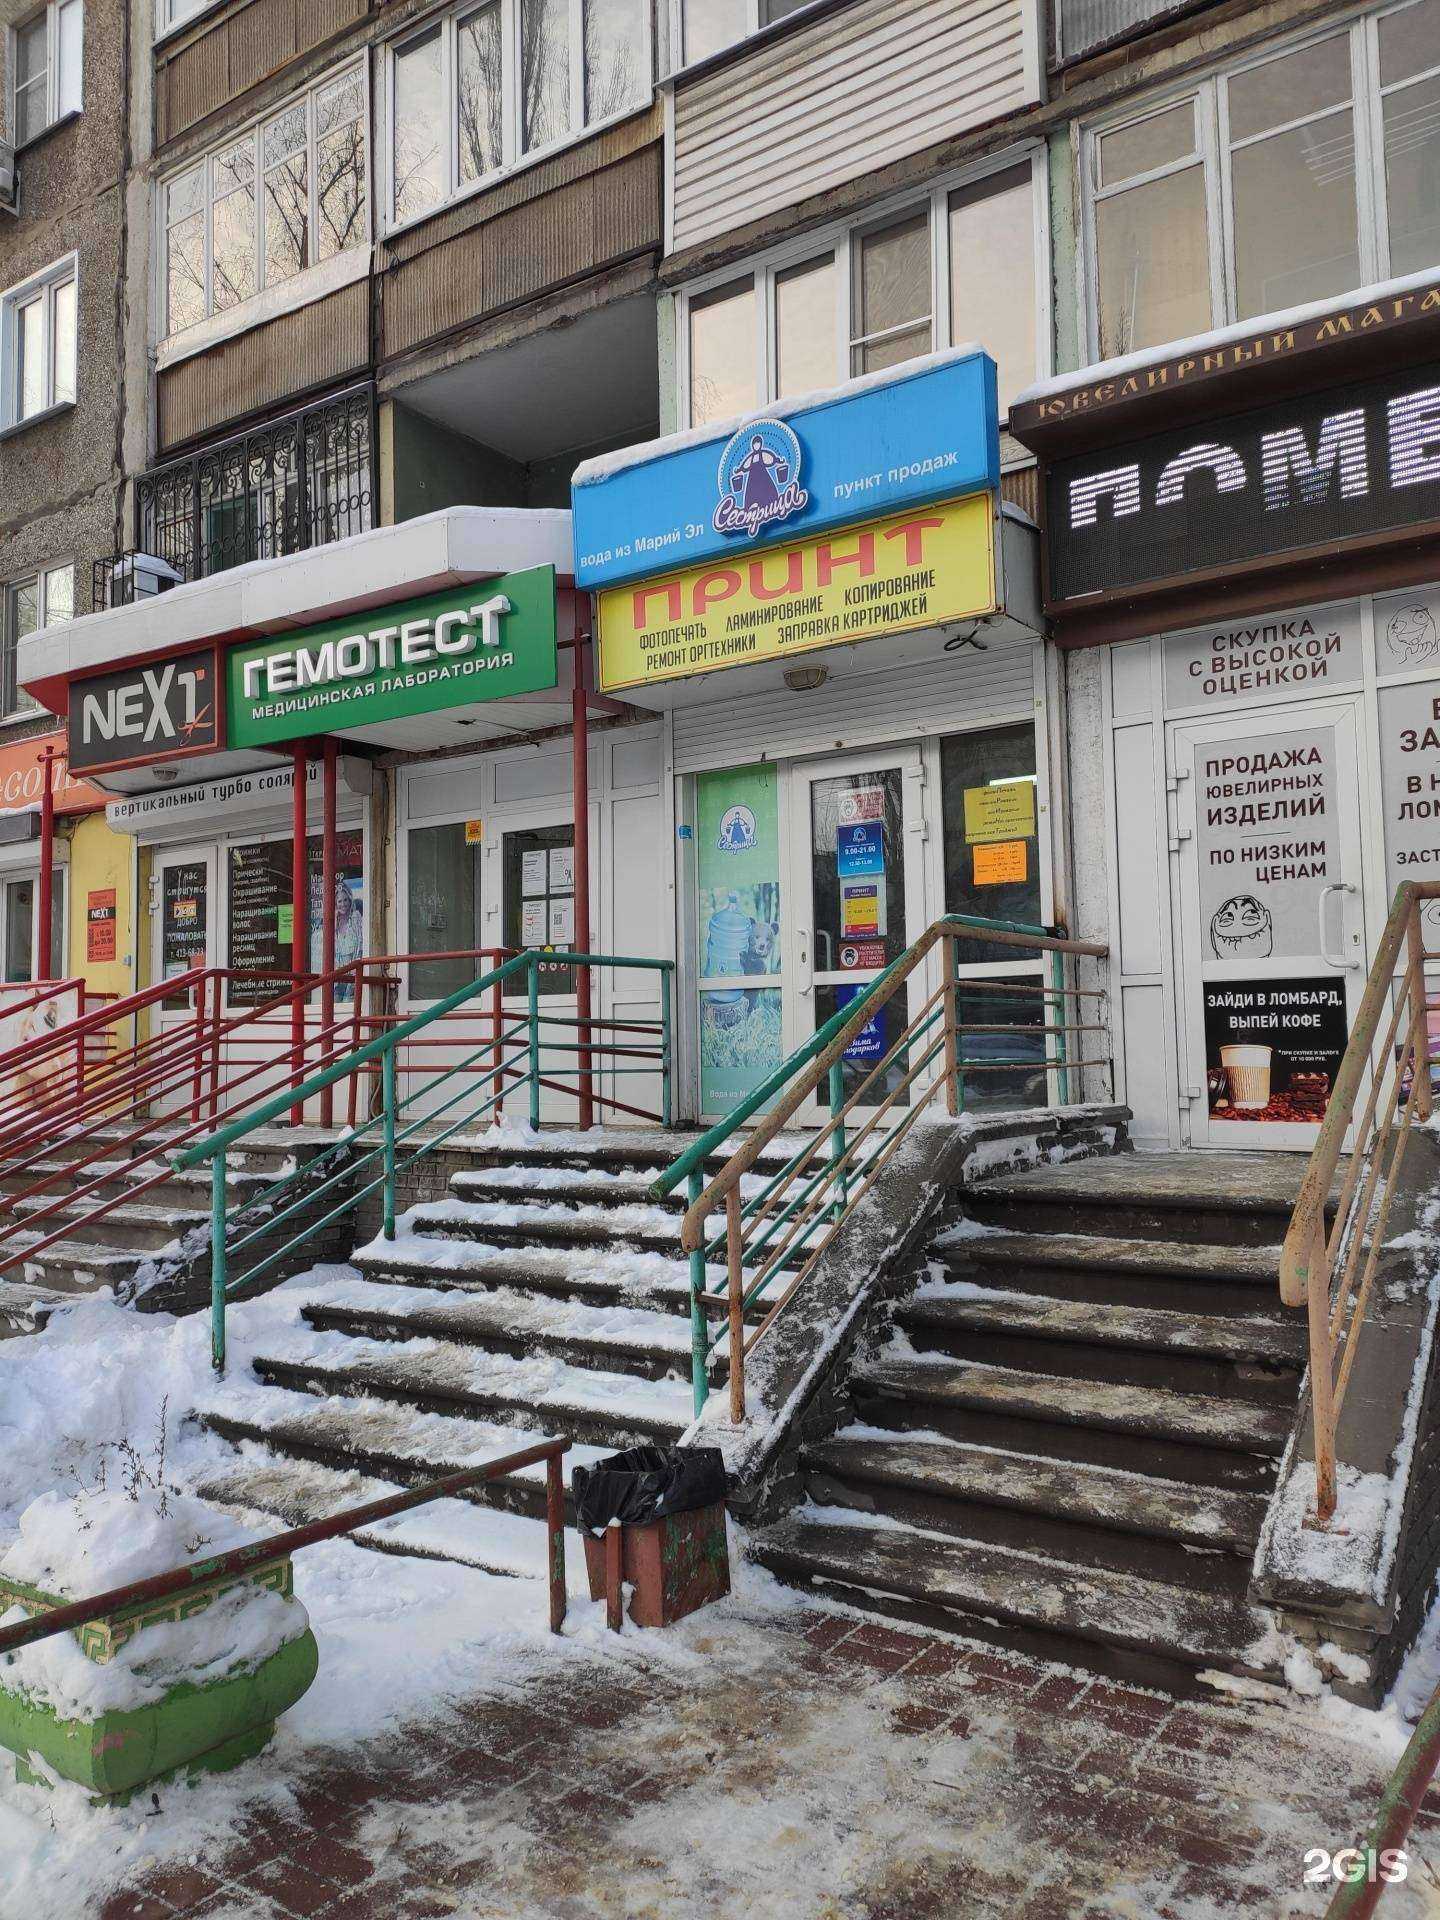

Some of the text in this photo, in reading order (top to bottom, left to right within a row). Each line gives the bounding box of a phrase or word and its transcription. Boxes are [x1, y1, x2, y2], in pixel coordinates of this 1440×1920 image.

[1038, 330, 1296, 419] ЮВЕЛИРНЫЙ
[833, 450, 958, 498] пункт продаж
[713, 482, 807, 536] Сестрица
[580, 523, 704, 568] вода из Марий Эл
[633, 518, 944, 629] ПРИНТ
[640, 569, 936, 650] ФОТОПЕЧАТЬ ЛАМИНИРОВАНИЕ КОПИРОВАНИЕ
[243, 594, 511, 699] ГЕМОТЕСТ
[646, 594, 929, 671] РЕМОНТ ОРГТЕХНИКИ ЗАПРАВКА КАРТРИДЖЕЙ
[1212, 618, 1316, 653] СКУПКА
[1189, 632, 1342, 677] С ВЫСОКОЙ
[252, 652, 514, 720] МЕДИЦИНСКАЯ ЛАБОРАТОРИЯ
[1202, 658, 1328, 696] ОЦЕНКОЙ
[1206, 747, 1323, 778] ПРОДАЖА
[114, 787, 205, 817] вертикальный
[212, 778, 251, 801] турбо
[1206, 773, 1324, 800] ЮВЕЛИРНЫХ
[1207, 792, 1326, 827] ИЗДЕЛИЙ
[1210, 841, 1326, 866] ПО НИЗКИМ
[1256, 862, 1327, 884] ЦЕНАМ
[233, 930, 277, 943] Наращивание
[1208, 990, 1343, 1008] ЗАЙДИ В ЛОМБАРД,
[1229, 1013, 1321, 1029] ВЫПЕЙ КОФЕ
